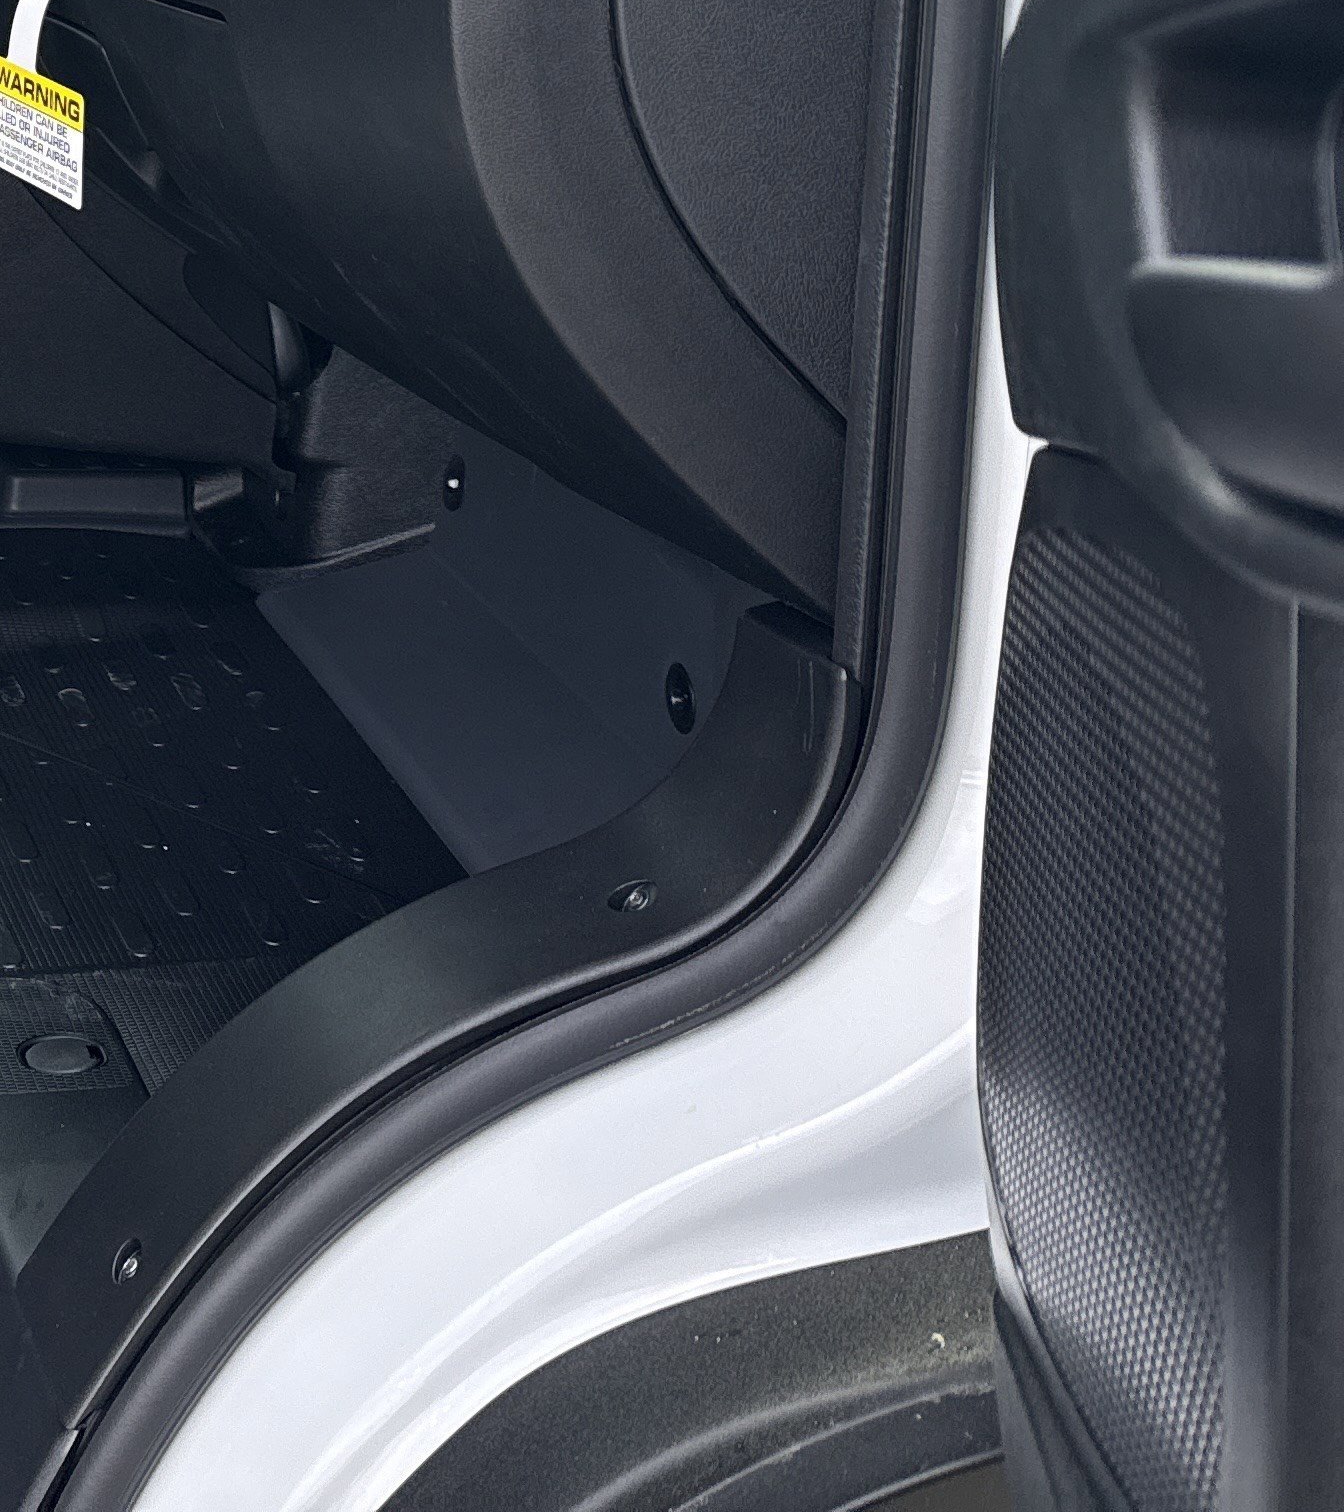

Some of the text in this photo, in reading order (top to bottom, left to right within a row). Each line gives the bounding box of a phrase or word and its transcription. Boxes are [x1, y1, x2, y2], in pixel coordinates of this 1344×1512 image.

[18, 117, 30, 134] OR
[33, 125, 70, 155] INJURED
[35, 112, 54, 132] CAN
[56, 122, 67, 139] BE
[45, 146, 77, 173] AIRBAG
